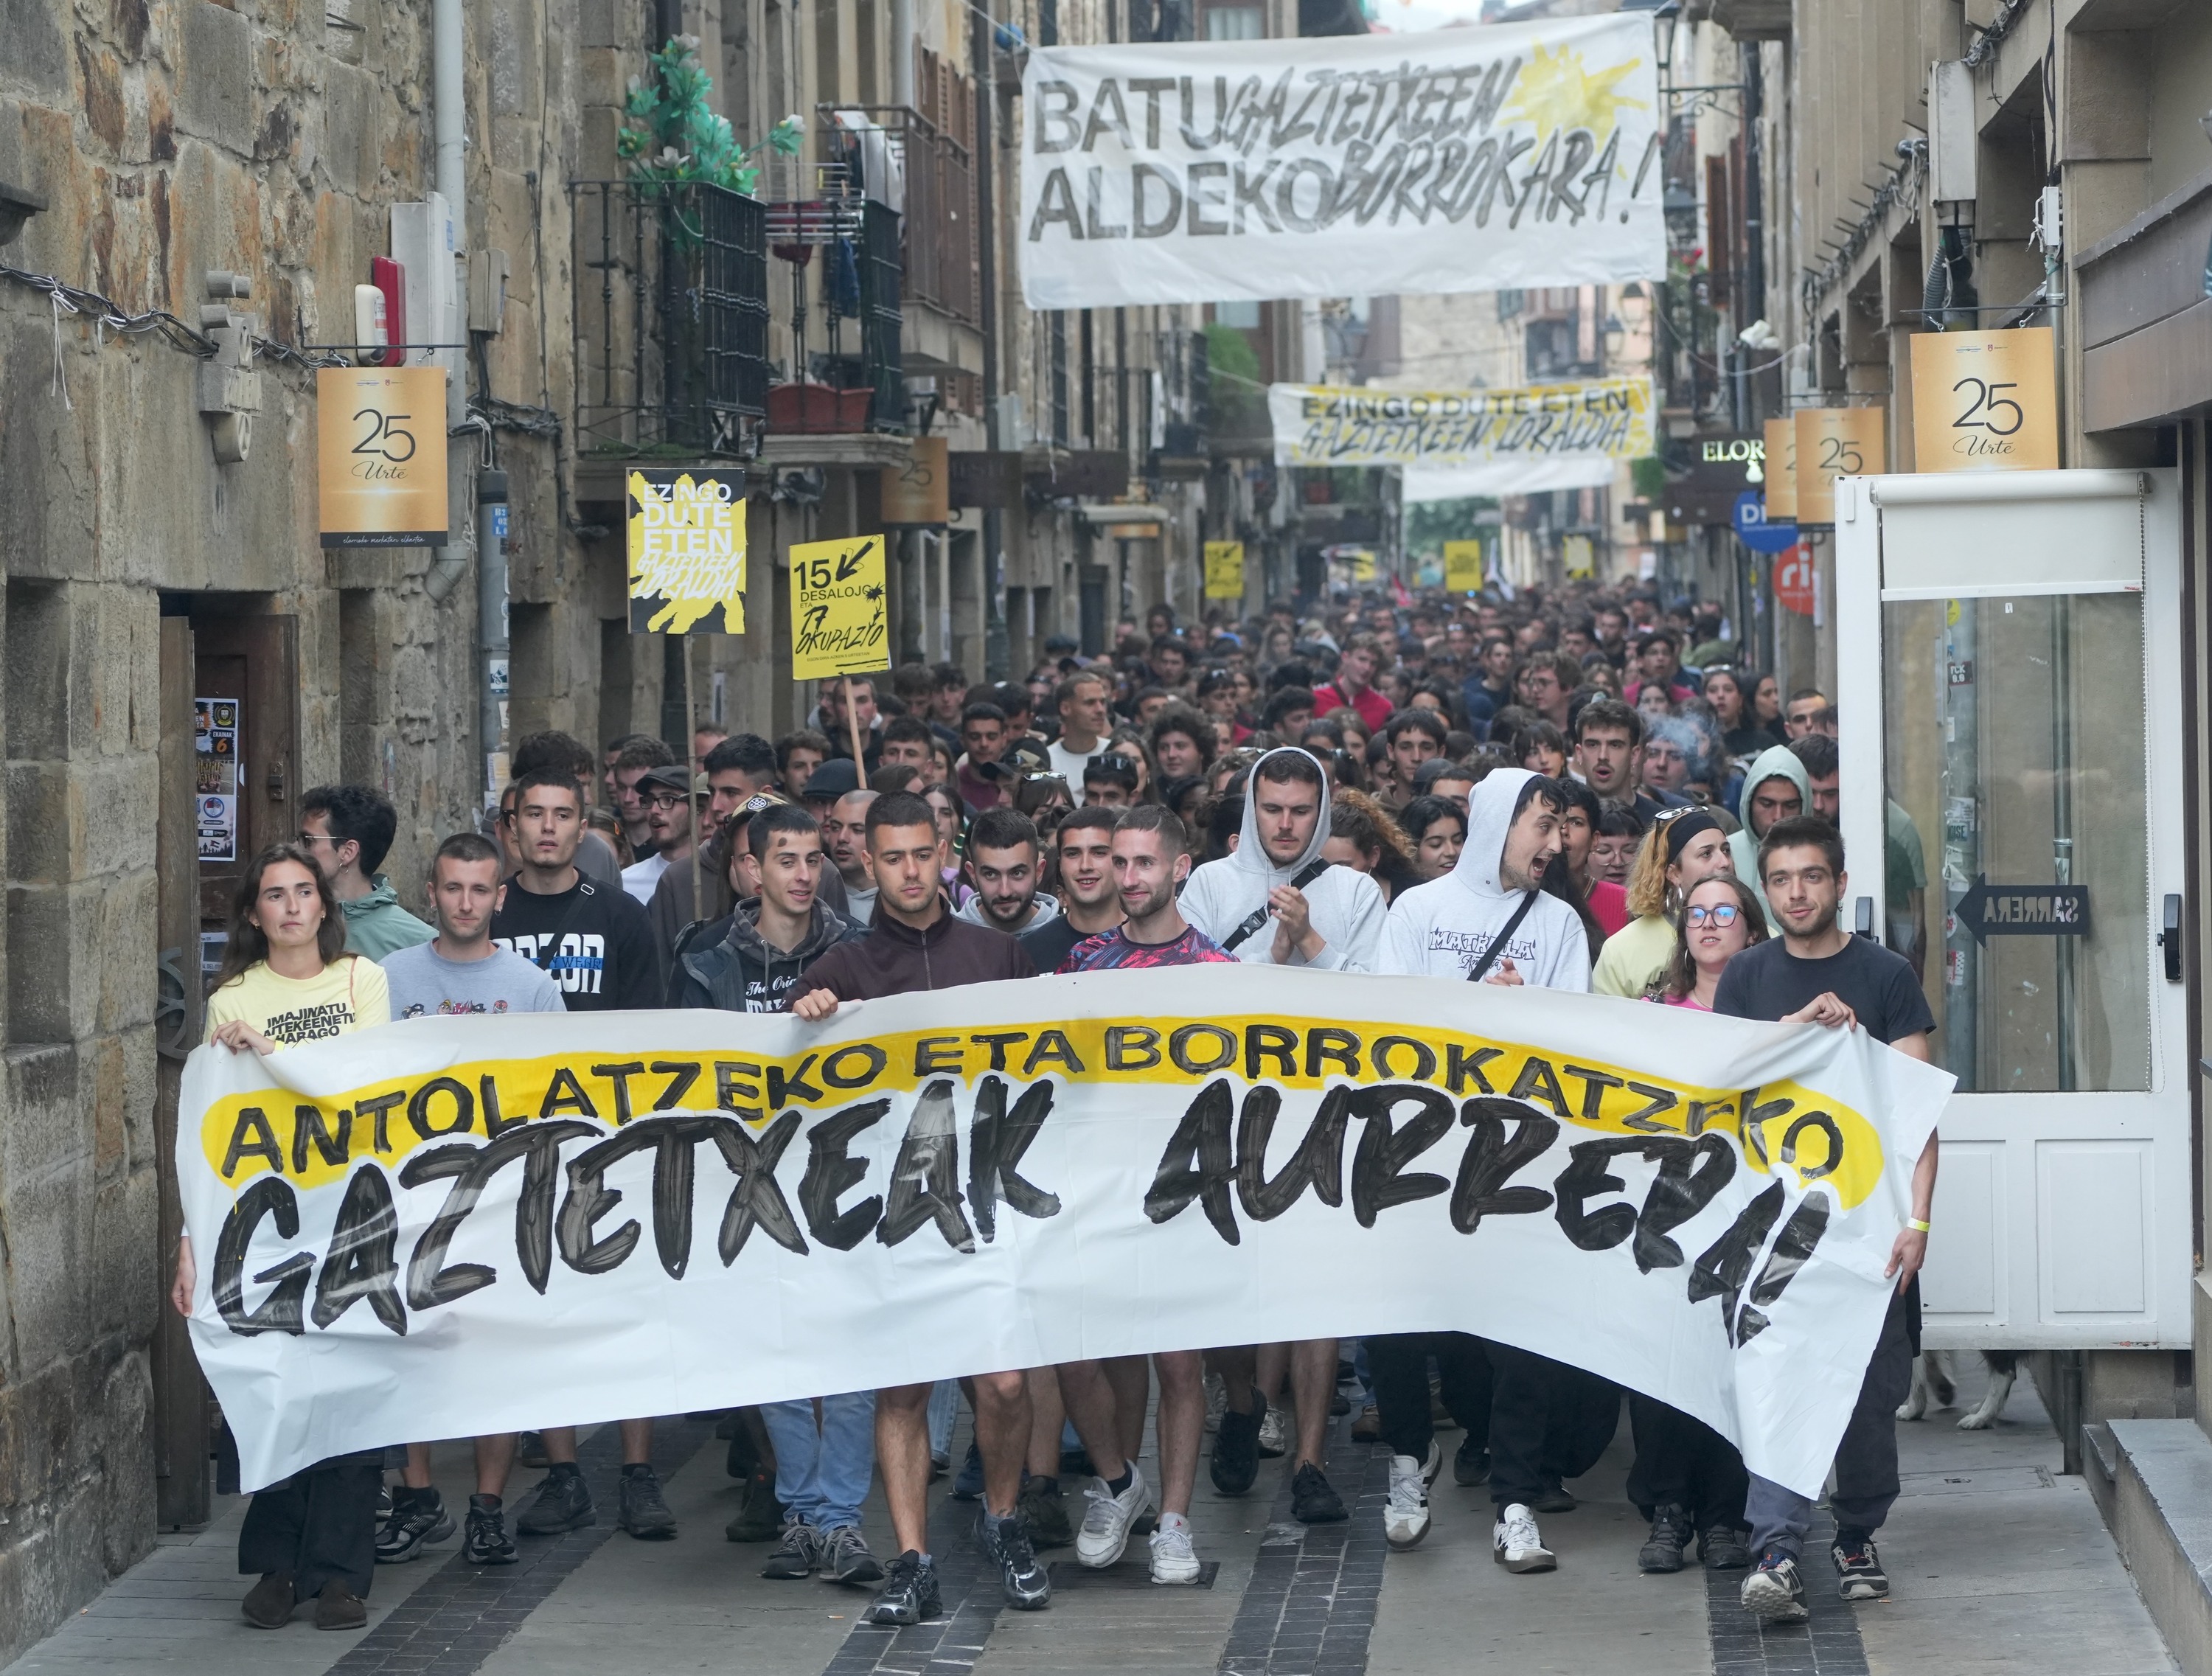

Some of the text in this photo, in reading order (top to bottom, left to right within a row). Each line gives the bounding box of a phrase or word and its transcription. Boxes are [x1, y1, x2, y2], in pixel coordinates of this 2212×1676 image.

[1034, 57, 1522, 158] BATU GAZTETXEEN
[1029, 159, 1331, 242] ALDEKO
[1302, 388, 1629, 420] EZINGO DUTE ETEN
[1953, 378, 2023, 436] 25
[352, 408, 416, 462] 25
[1952, 434, 2016, 456] Urte
[351, 460, 408, 480] Urte
[1819, 437, 1864, 473] 25
[900, 457, 933, 486] 25
[644, 483, 731, 501] EZINGO
[643, 503, 732, 527] DUTE
[644, 529, 732, 554] ETEN
[794, 558, 831, 591] 15
[801, 605, 829, 635] 17
[796, 624, 884, 655] OKUPAZIO
[216, 738, 227, 753] 6
[745, 981, 769, 995] The
[267, 1003, 347, 1028] IMAJINATU
[221, 1043, 886, 1178] ANTOLATZEKO
[914, 1030, 1085, 1077] ETA
[212, 1075, 1830, 1349] GAZTETXEAK AURRERA!
